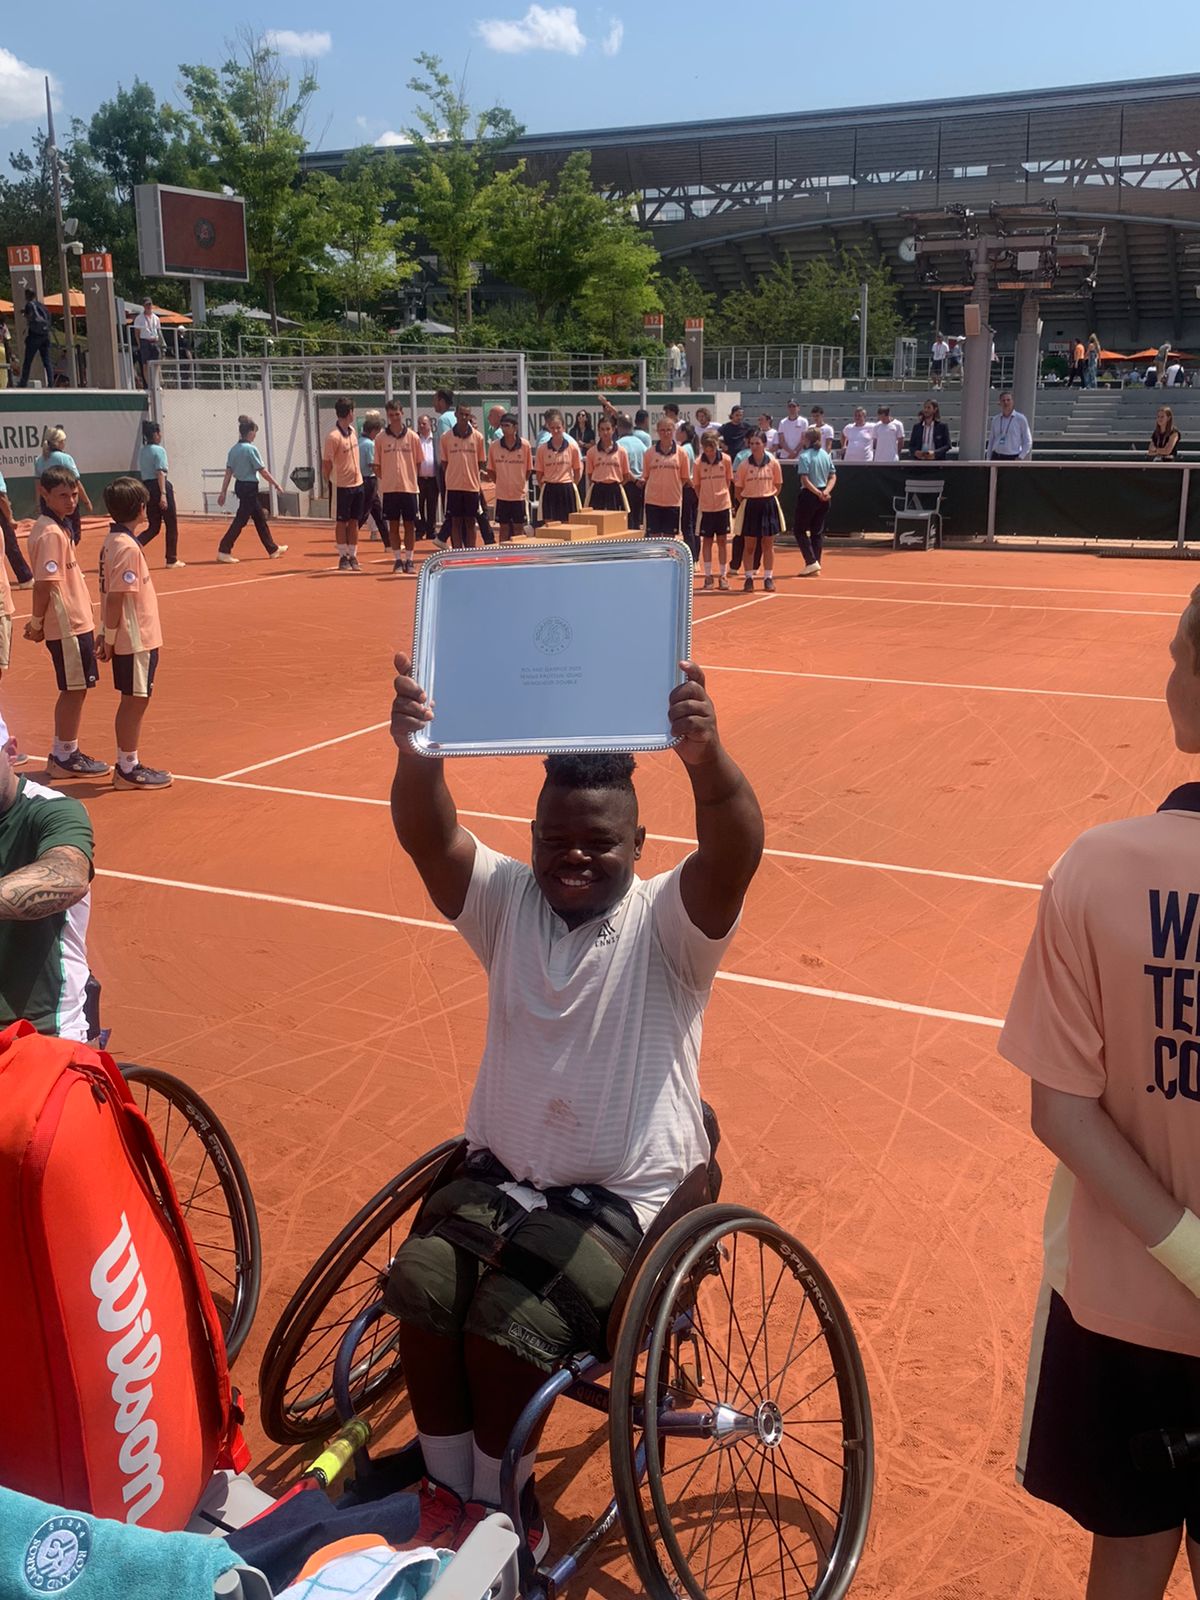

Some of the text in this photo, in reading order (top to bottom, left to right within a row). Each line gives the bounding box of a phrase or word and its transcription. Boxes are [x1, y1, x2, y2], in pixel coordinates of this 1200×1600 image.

[16, 248, 31, 263] 13
[90, 256, 104, 271] 12
[602, 376, 612, 385] 12
[0, 453, 38, 466] hangin
[1149, 889, 1200, 962] W
[90, 1211, 164, 1526] Wilson
[26, 1538, 88, 1590] ROLAND GARROS
